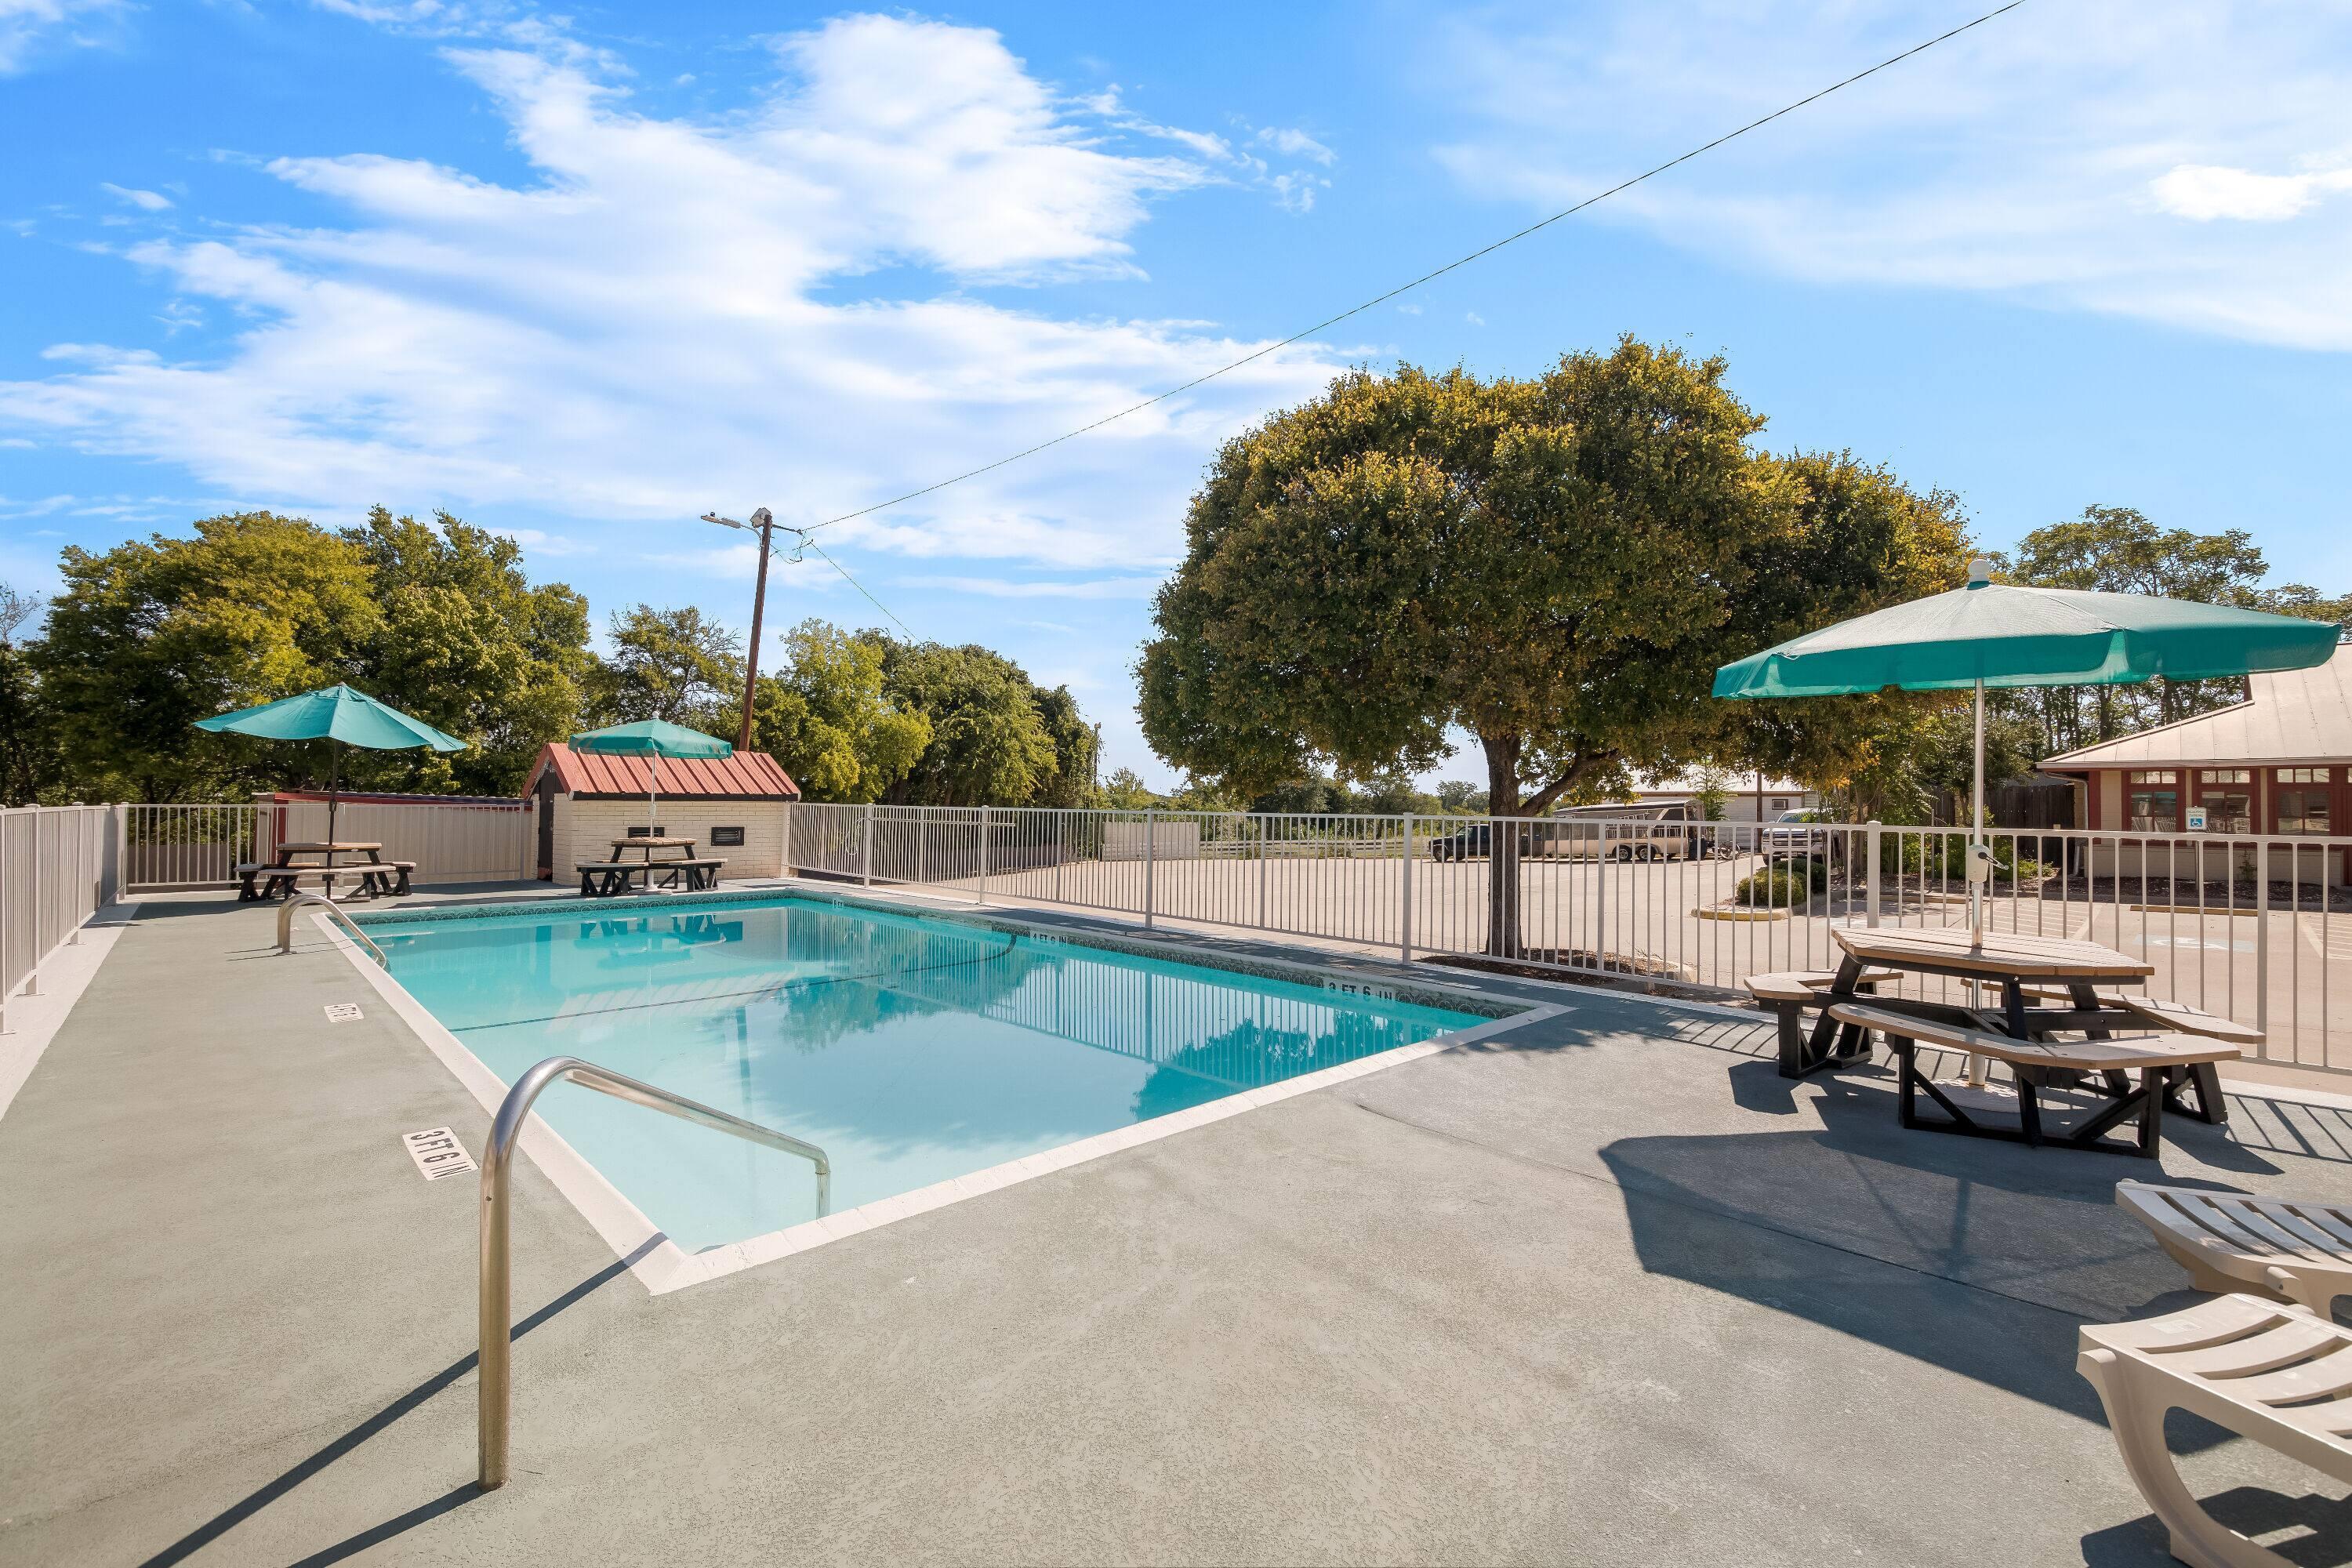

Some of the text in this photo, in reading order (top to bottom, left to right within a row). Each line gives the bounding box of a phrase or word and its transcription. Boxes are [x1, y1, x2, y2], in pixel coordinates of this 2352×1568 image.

[1341, 983, 1357, 993] FT
[1379, 990, 1392, 1000] IN
[410, 1131, 472, 1178] 3 FT 6 IN
